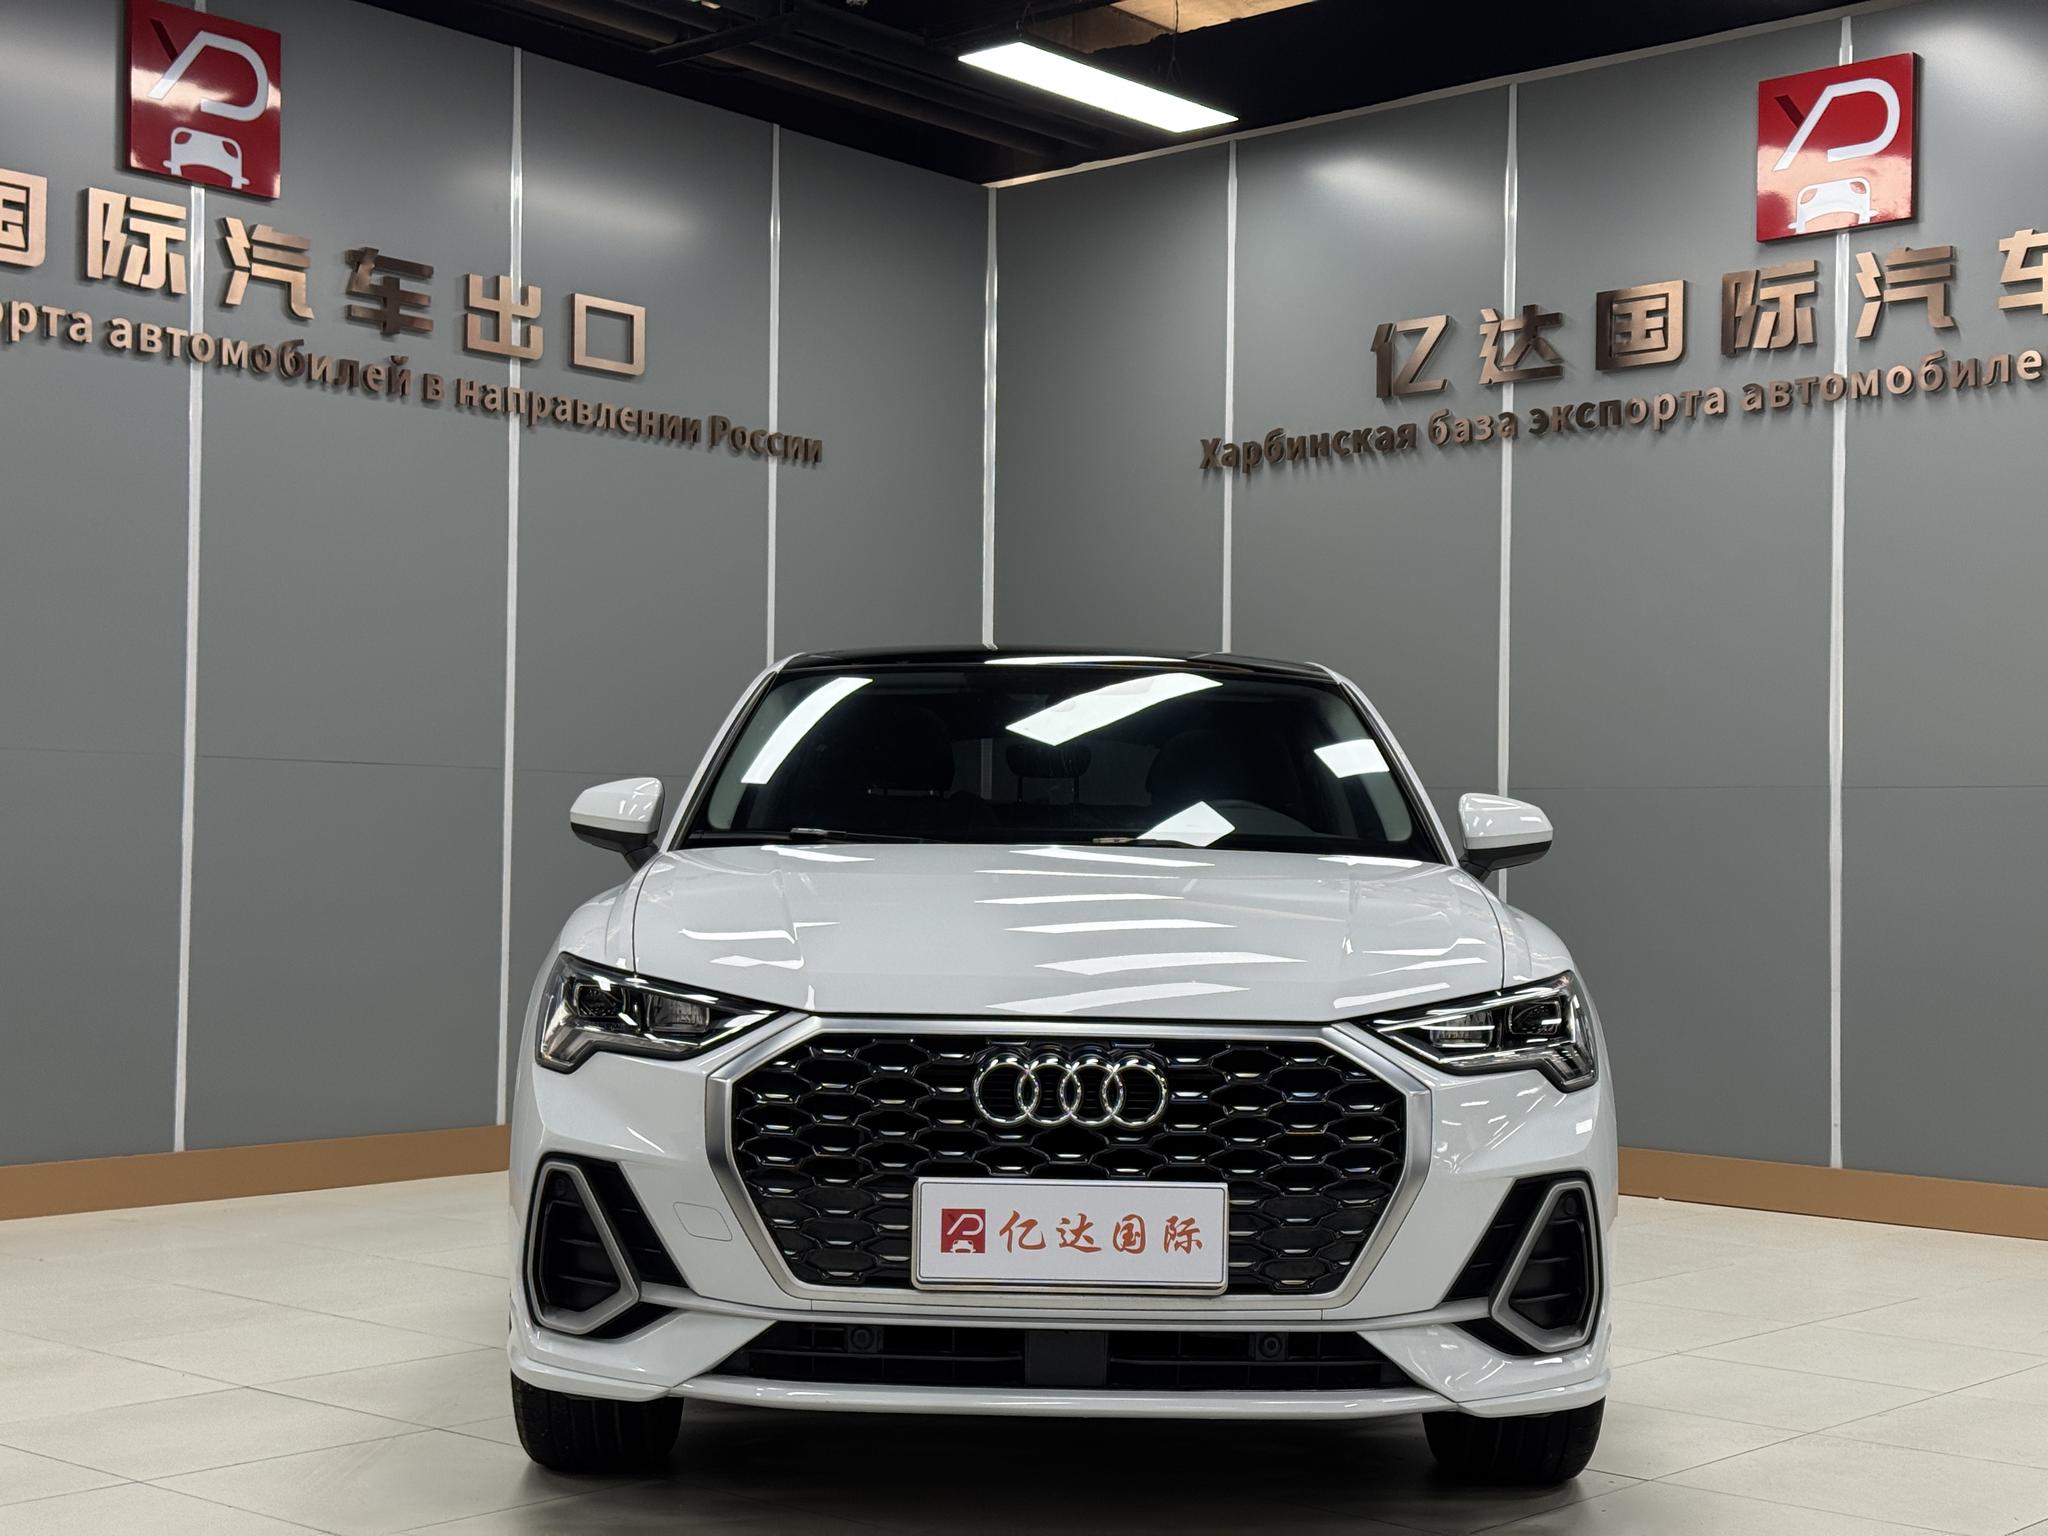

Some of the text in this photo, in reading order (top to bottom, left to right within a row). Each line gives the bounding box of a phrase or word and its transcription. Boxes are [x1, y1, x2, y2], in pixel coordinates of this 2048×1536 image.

[0, 300, 823, 464] рта автомобилей в направлении России
[1200, 350, 2044, 474] Харбинская база экспорта автомобиле
[999, 1210, 1203, 1254] 亿达国际
